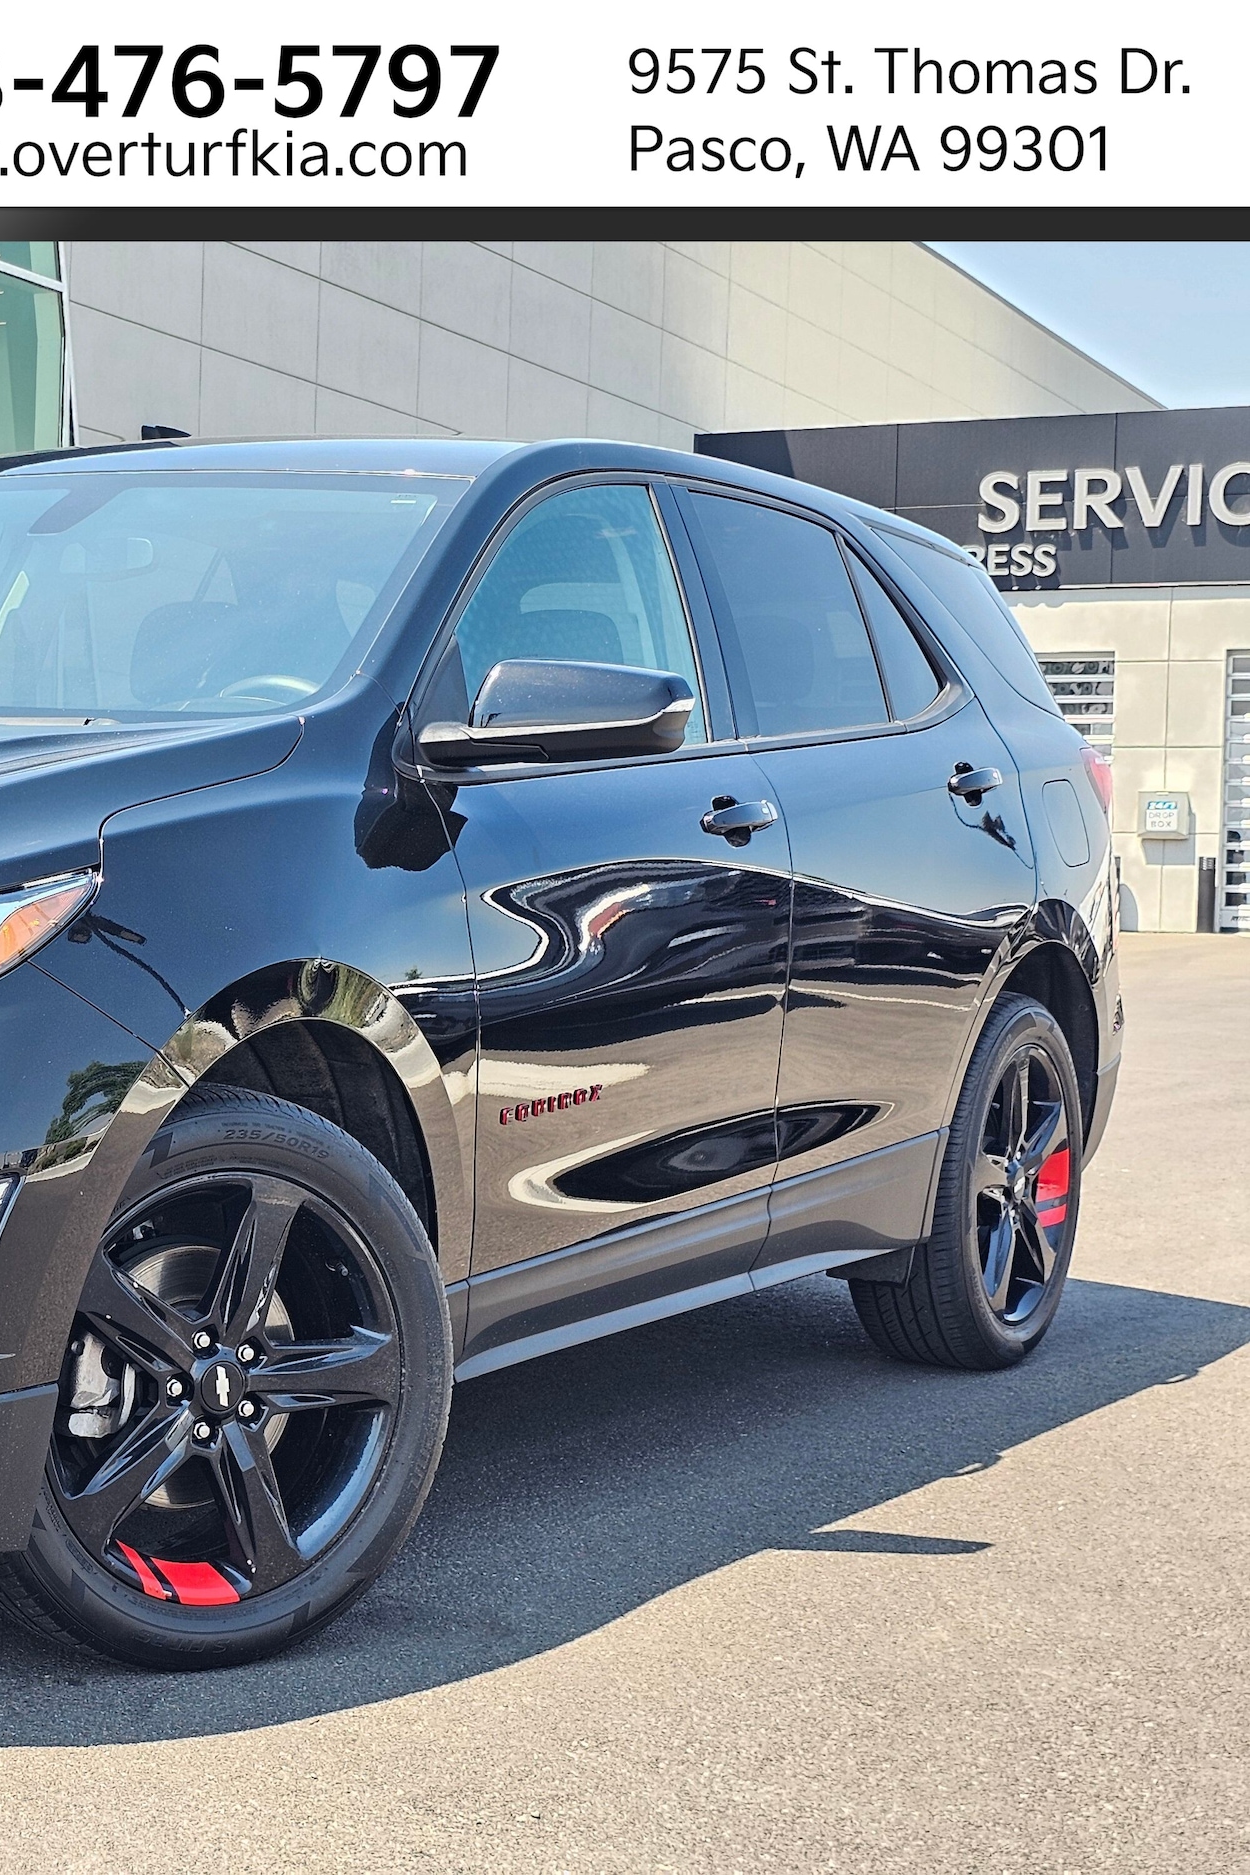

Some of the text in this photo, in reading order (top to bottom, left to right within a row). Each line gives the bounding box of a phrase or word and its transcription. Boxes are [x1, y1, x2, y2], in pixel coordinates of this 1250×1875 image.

[977, 462, 1250, 534] SERVIC
[1148, 811, 1175, 819] DROP
[1150, 820, 1172, 828] BOX
[499, 1084, 603, 1126] EQUINOX
[223, 1129, 330, 1159] 235/50R19
